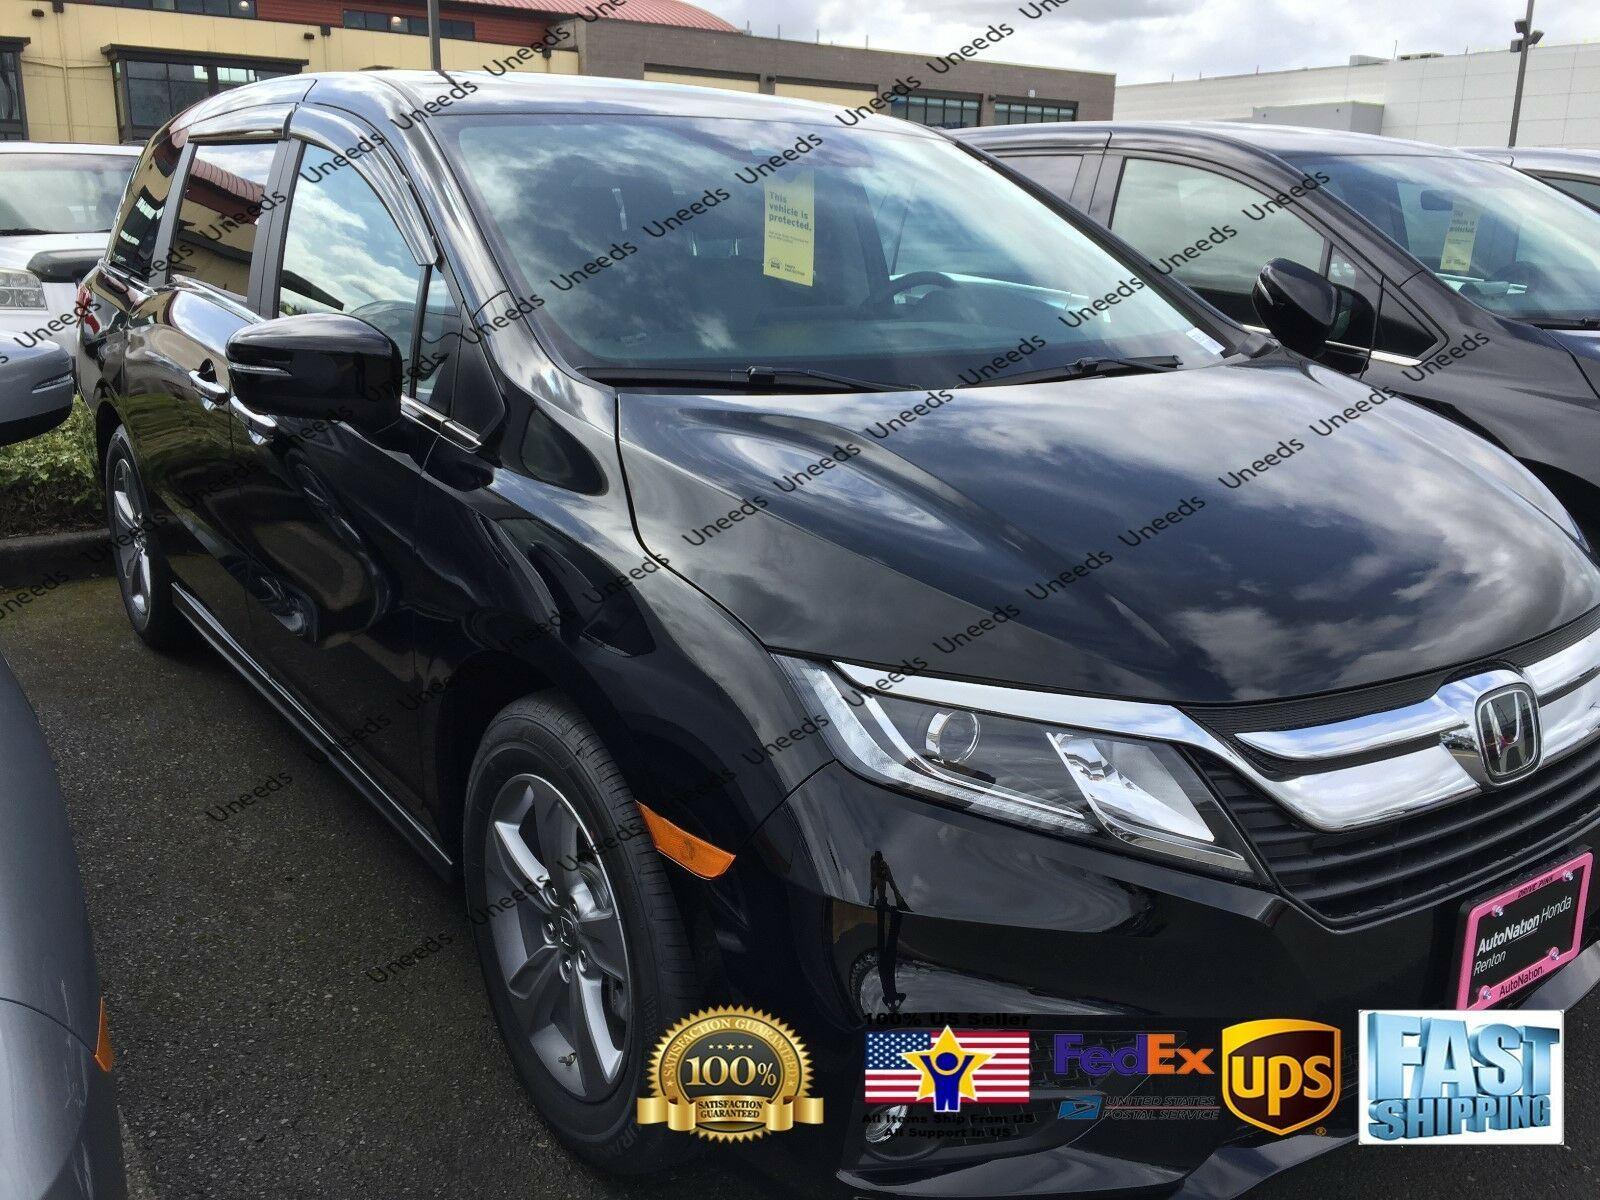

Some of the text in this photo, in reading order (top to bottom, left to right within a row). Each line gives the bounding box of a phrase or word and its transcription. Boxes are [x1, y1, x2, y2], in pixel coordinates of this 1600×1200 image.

[769, 191, 788, 203] This
[769, 203, 808, 220] vehicle is
[769, 213, 812, 231] protected.
[1477, 896, 1572, 956] AutoNation Honda
[1473, 950, 1506, 976] Renton
[1500, 966, 1543, 997] AutoNation
